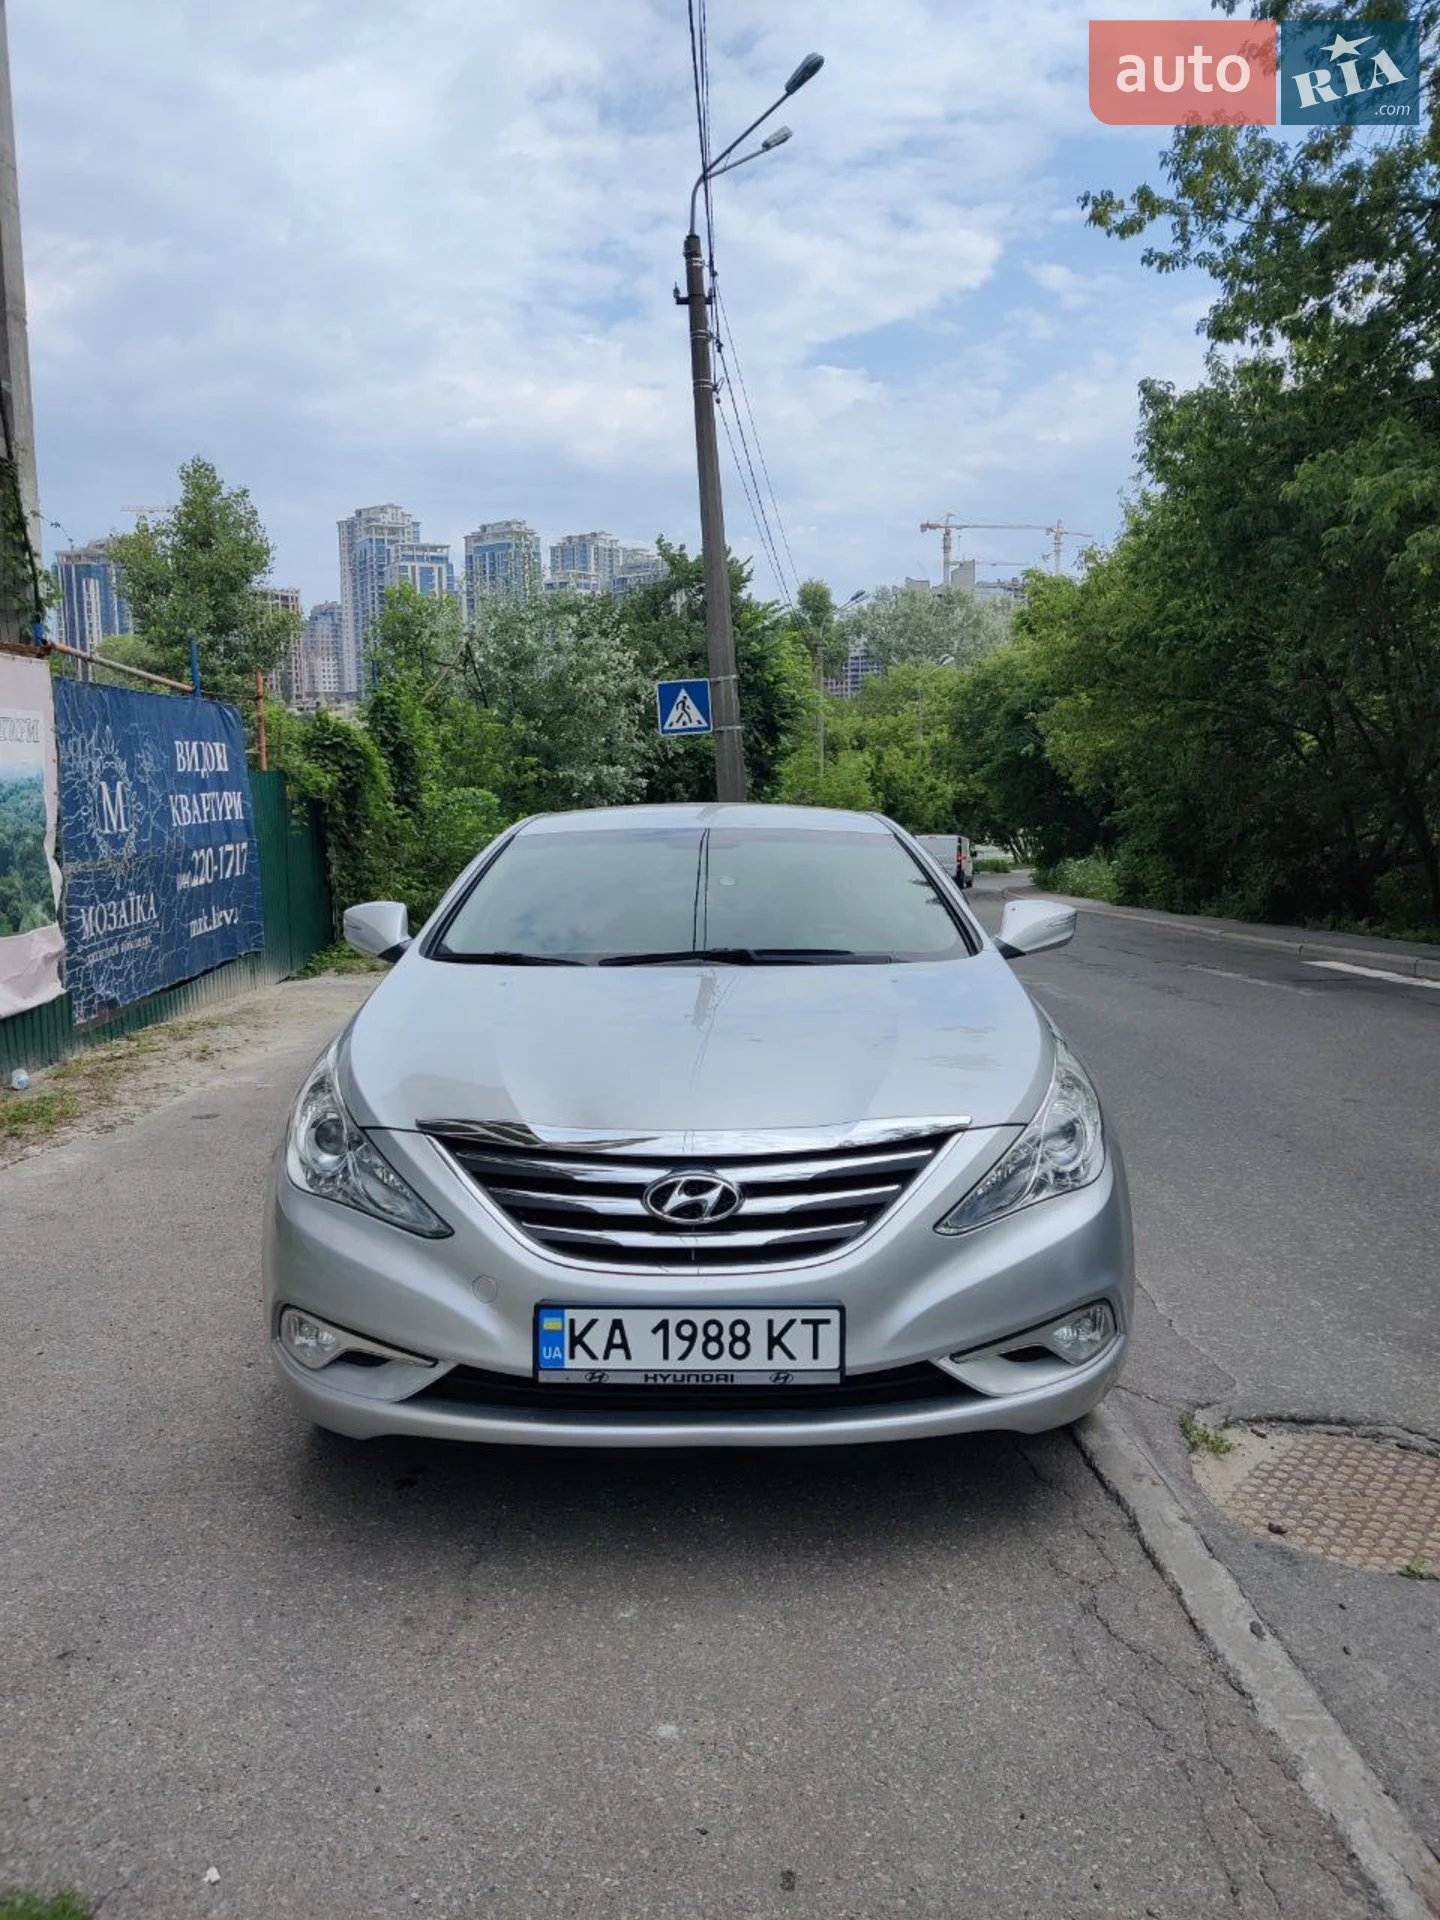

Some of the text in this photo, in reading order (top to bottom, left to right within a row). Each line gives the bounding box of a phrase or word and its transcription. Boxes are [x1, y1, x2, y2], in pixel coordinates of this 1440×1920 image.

[568, 1318, 831, 1361] KA 1988 KT
[542, 1347, 562, 1360] UA
[644, 1373, 734, 1383] HYUNDAI
